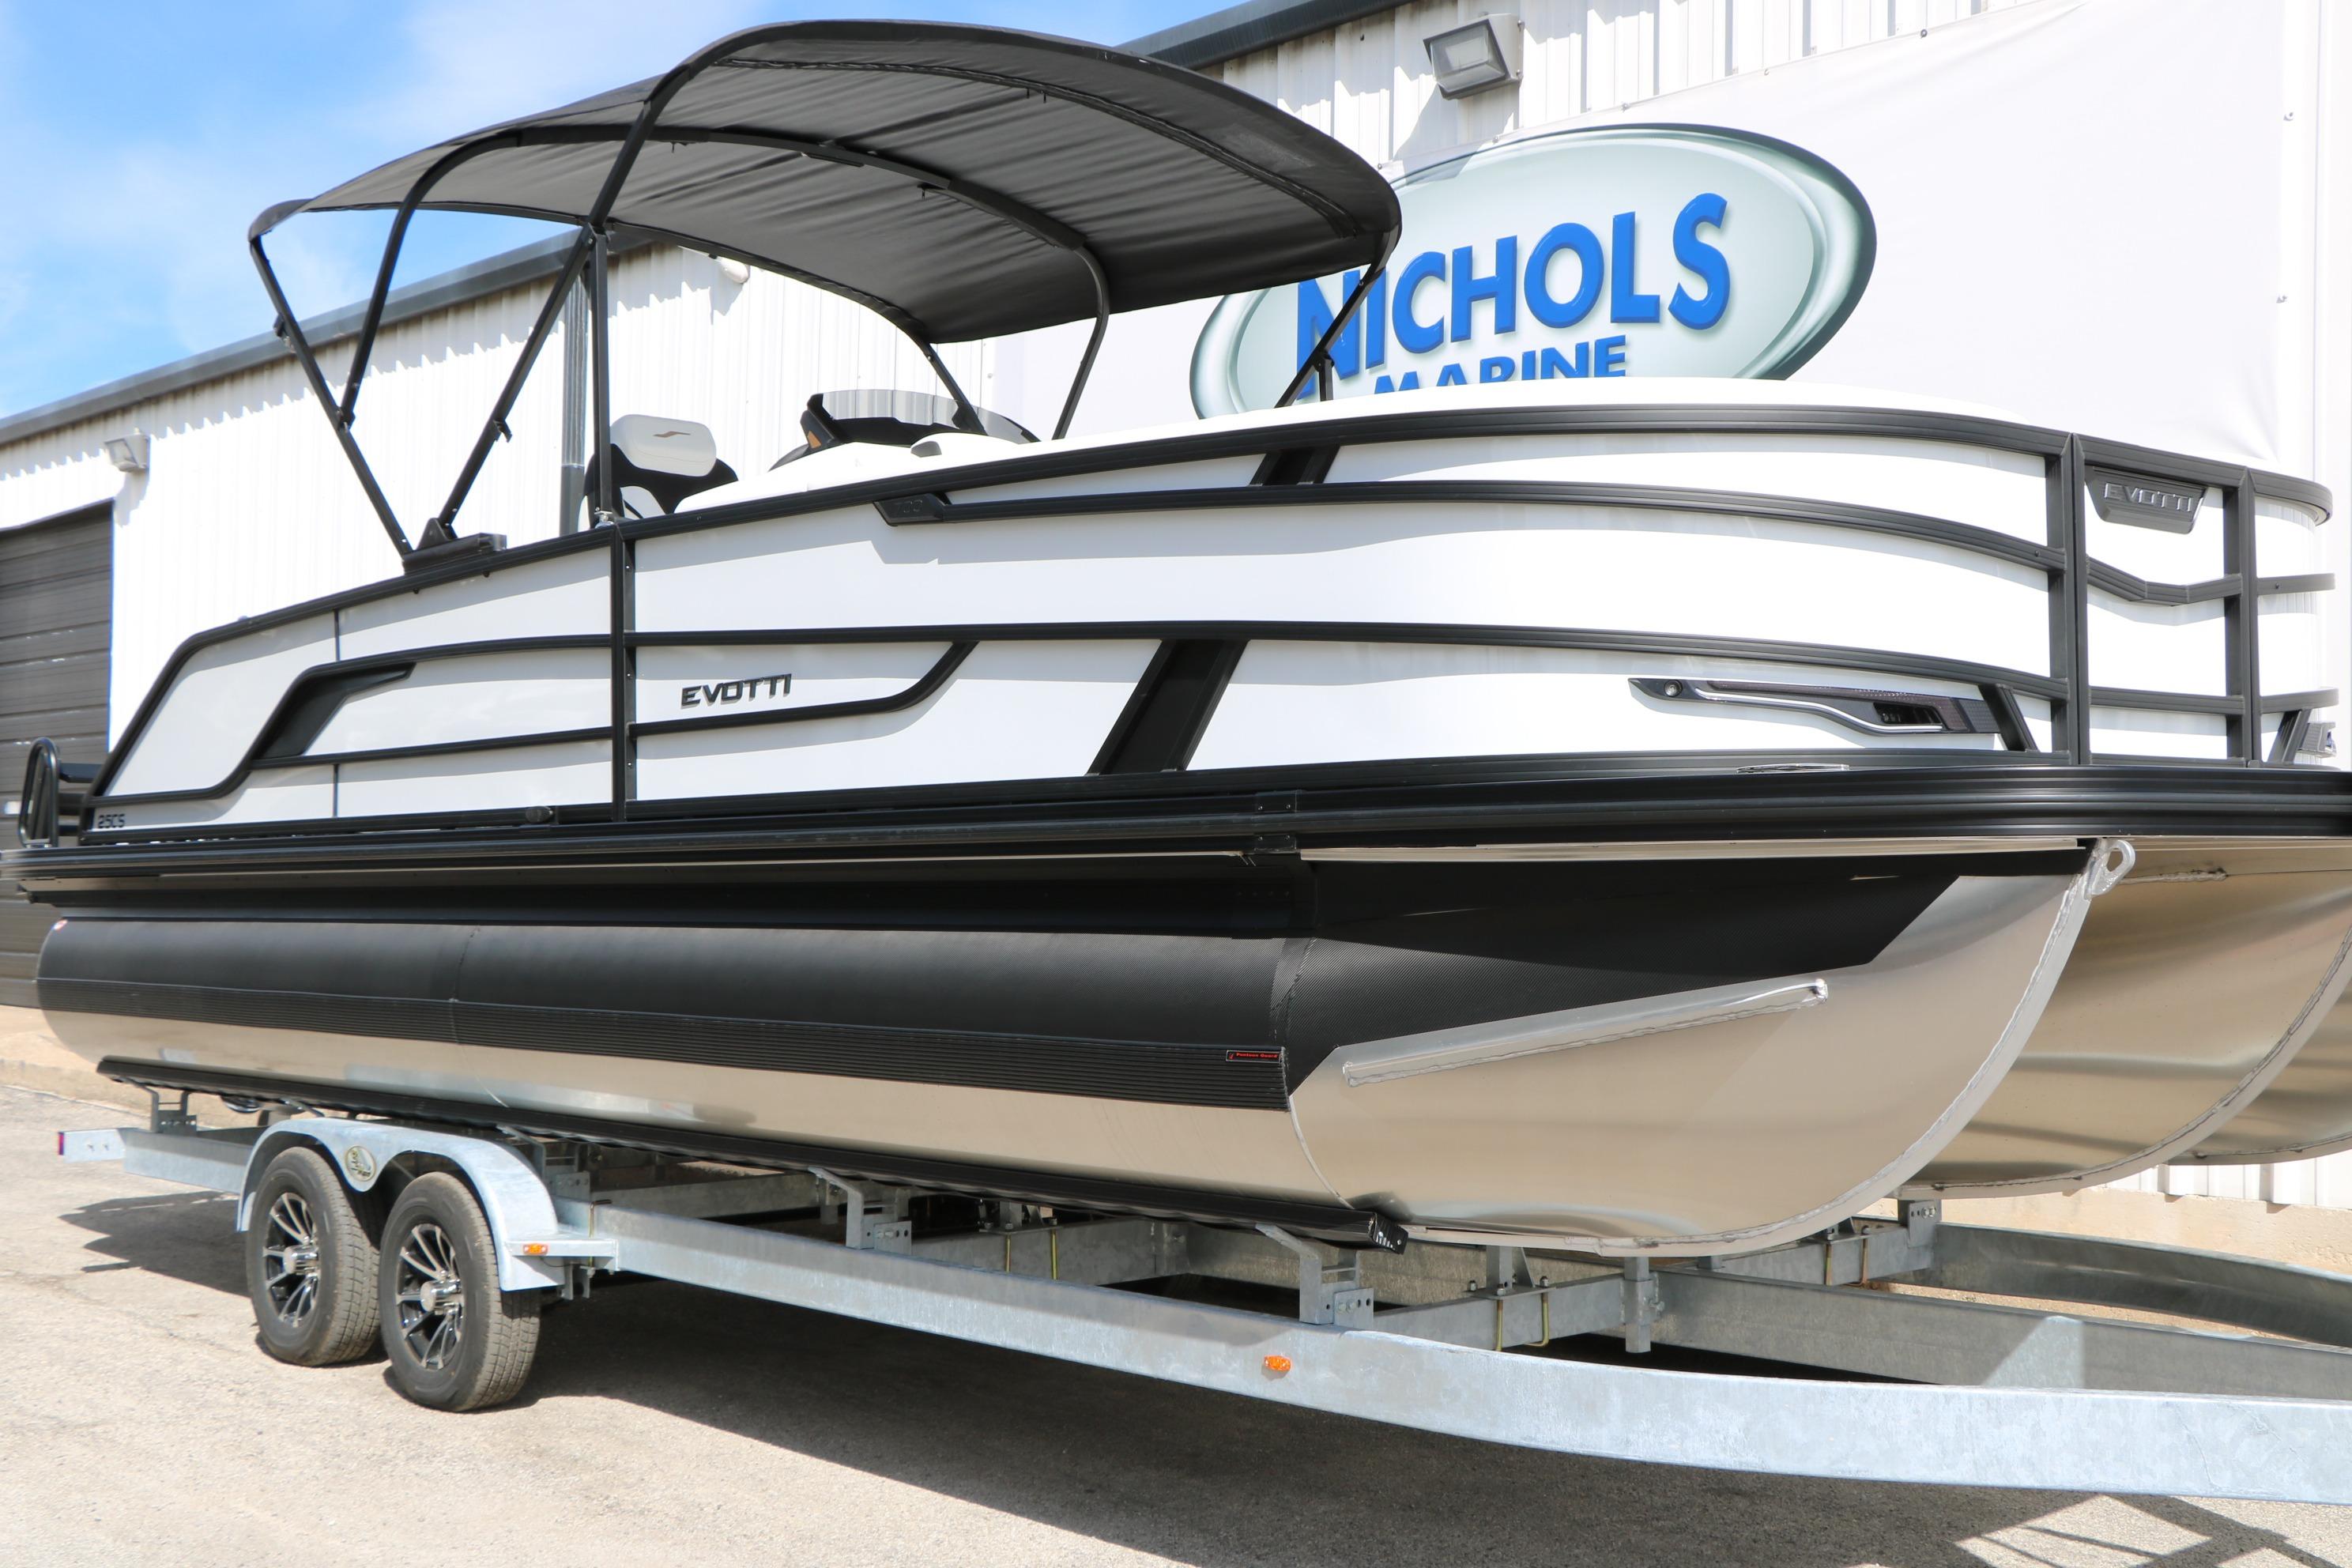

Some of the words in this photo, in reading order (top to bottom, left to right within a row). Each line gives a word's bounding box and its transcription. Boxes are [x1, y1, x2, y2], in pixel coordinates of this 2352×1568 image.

[1296, 192, 1731, 401] NICHOLS
[2104, 482, 2192, 513] EVOTTI
[681, 673, 792, 707] EVOTTI
